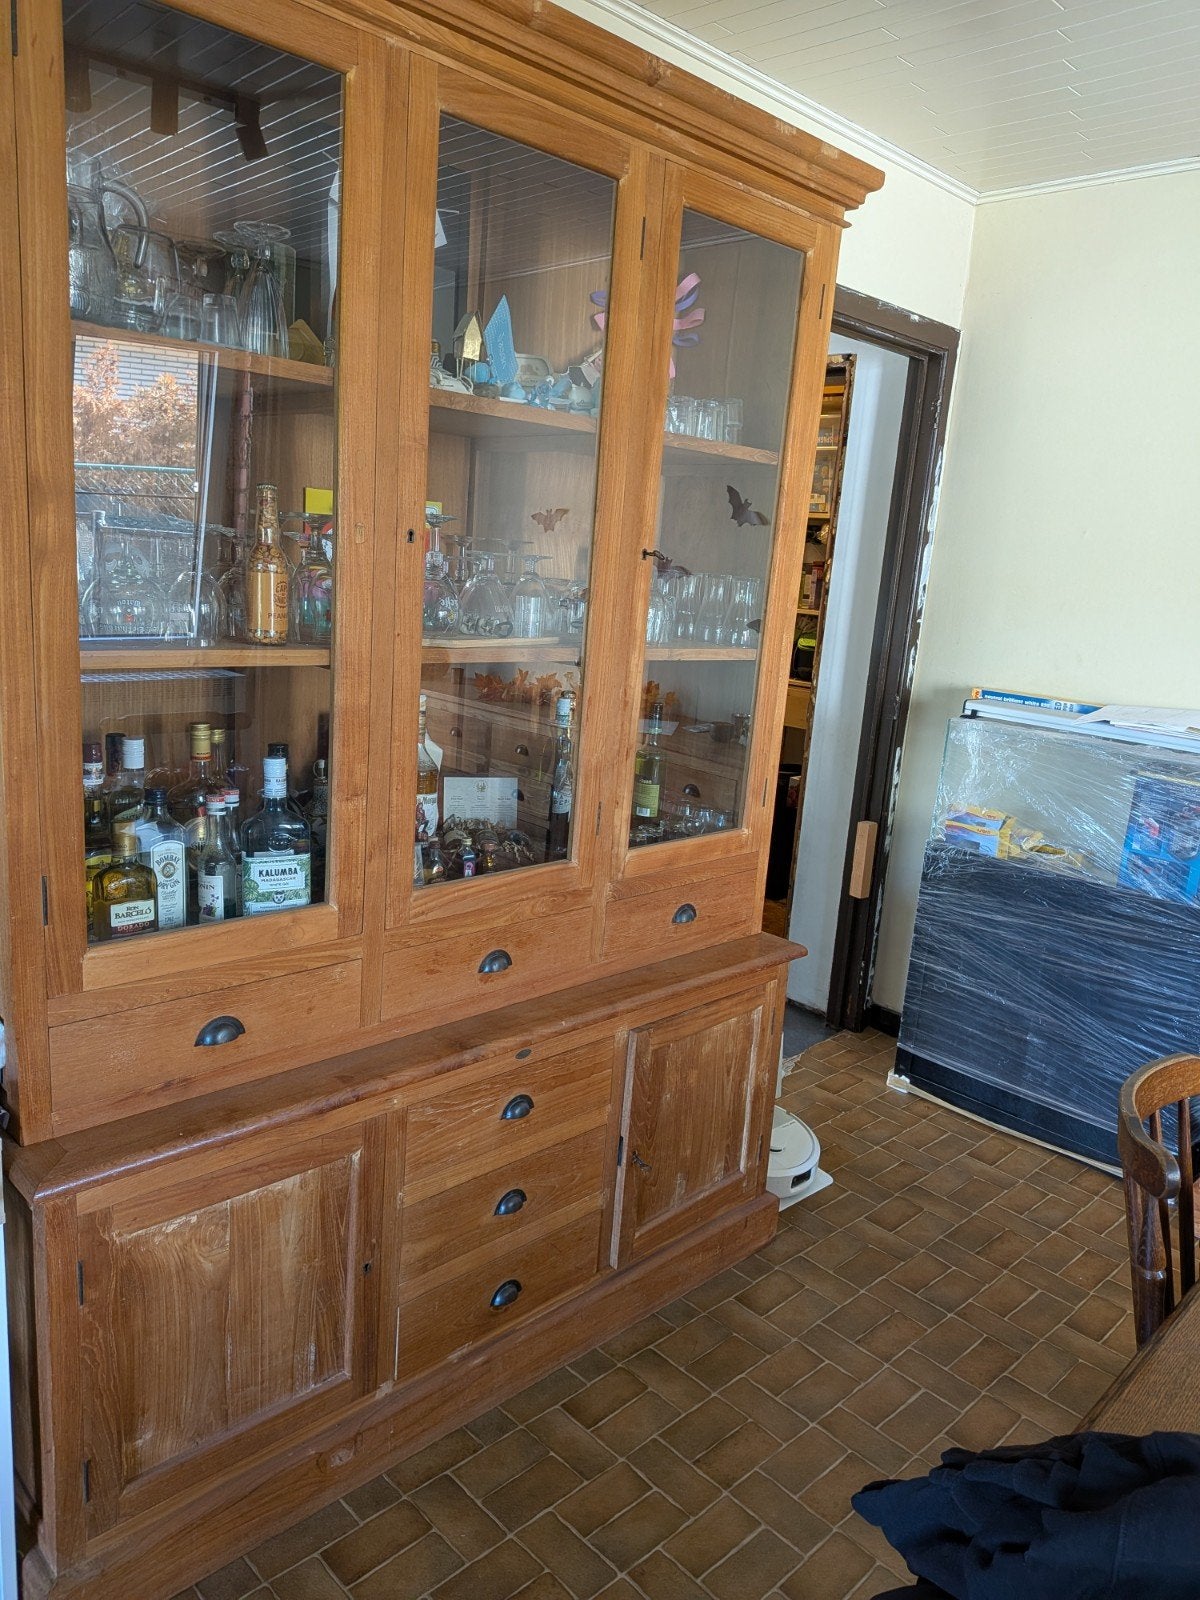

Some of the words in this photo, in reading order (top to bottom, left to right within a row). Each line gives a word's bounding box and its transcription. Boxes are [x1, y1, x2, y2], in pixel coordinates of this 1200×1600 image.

[155, 854, 181, 867] BOMBAY
[258, 867, 298, 877] KALUMBA
[114, 907, 152, 919] BARCELÓ
[117, 921, 150, 931] DORADO
